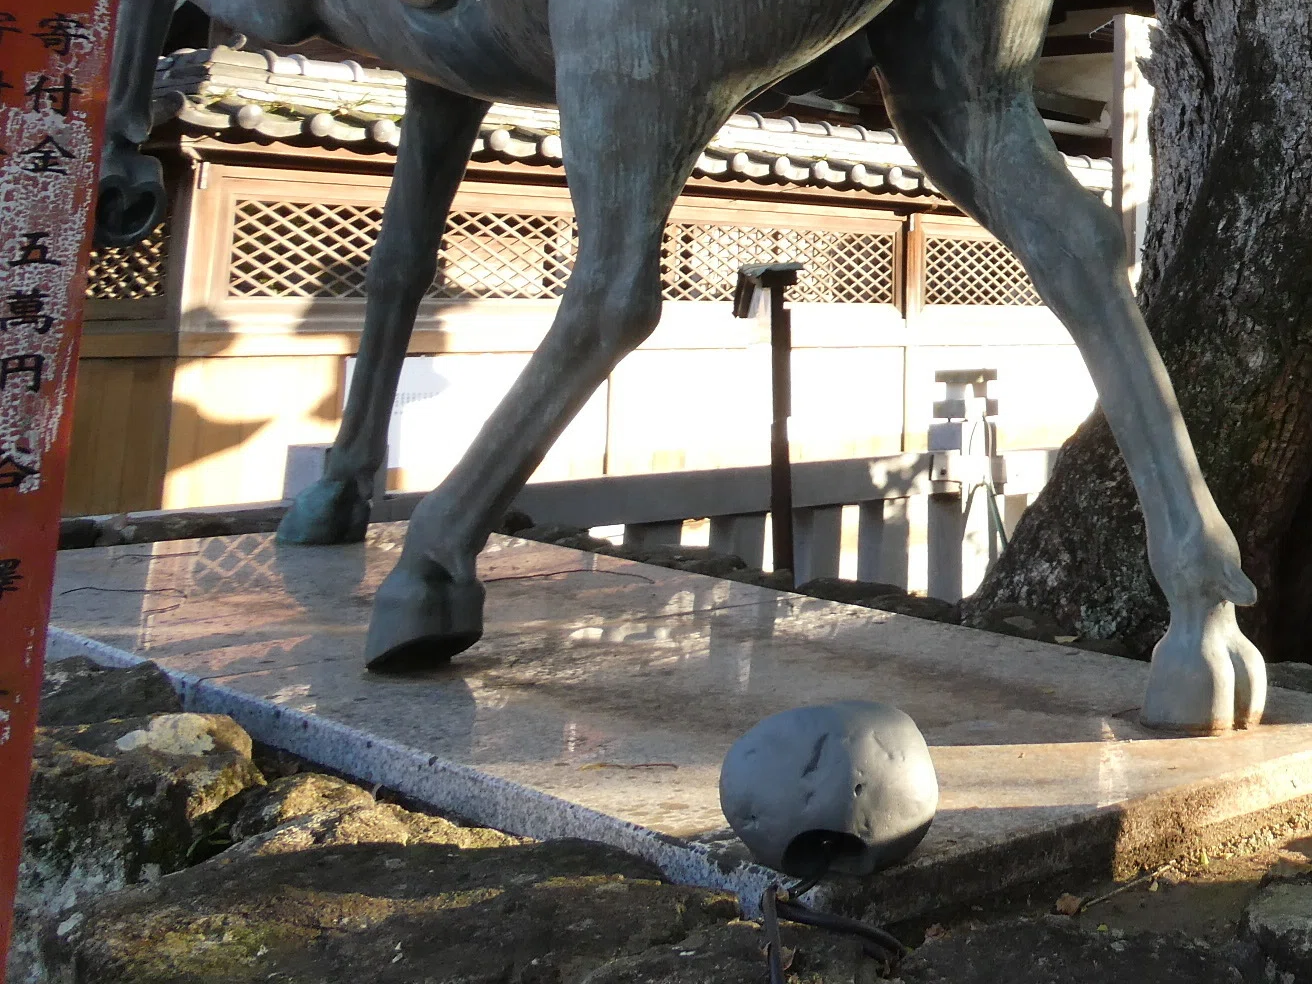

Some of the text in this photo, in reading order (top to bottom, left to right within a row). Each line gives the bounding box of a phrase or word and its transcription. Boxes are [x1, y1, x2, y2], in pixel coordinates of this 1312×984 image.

[20, 13, 90, 175] 寄付金
[0, 232, 61, 392] 五萬円
